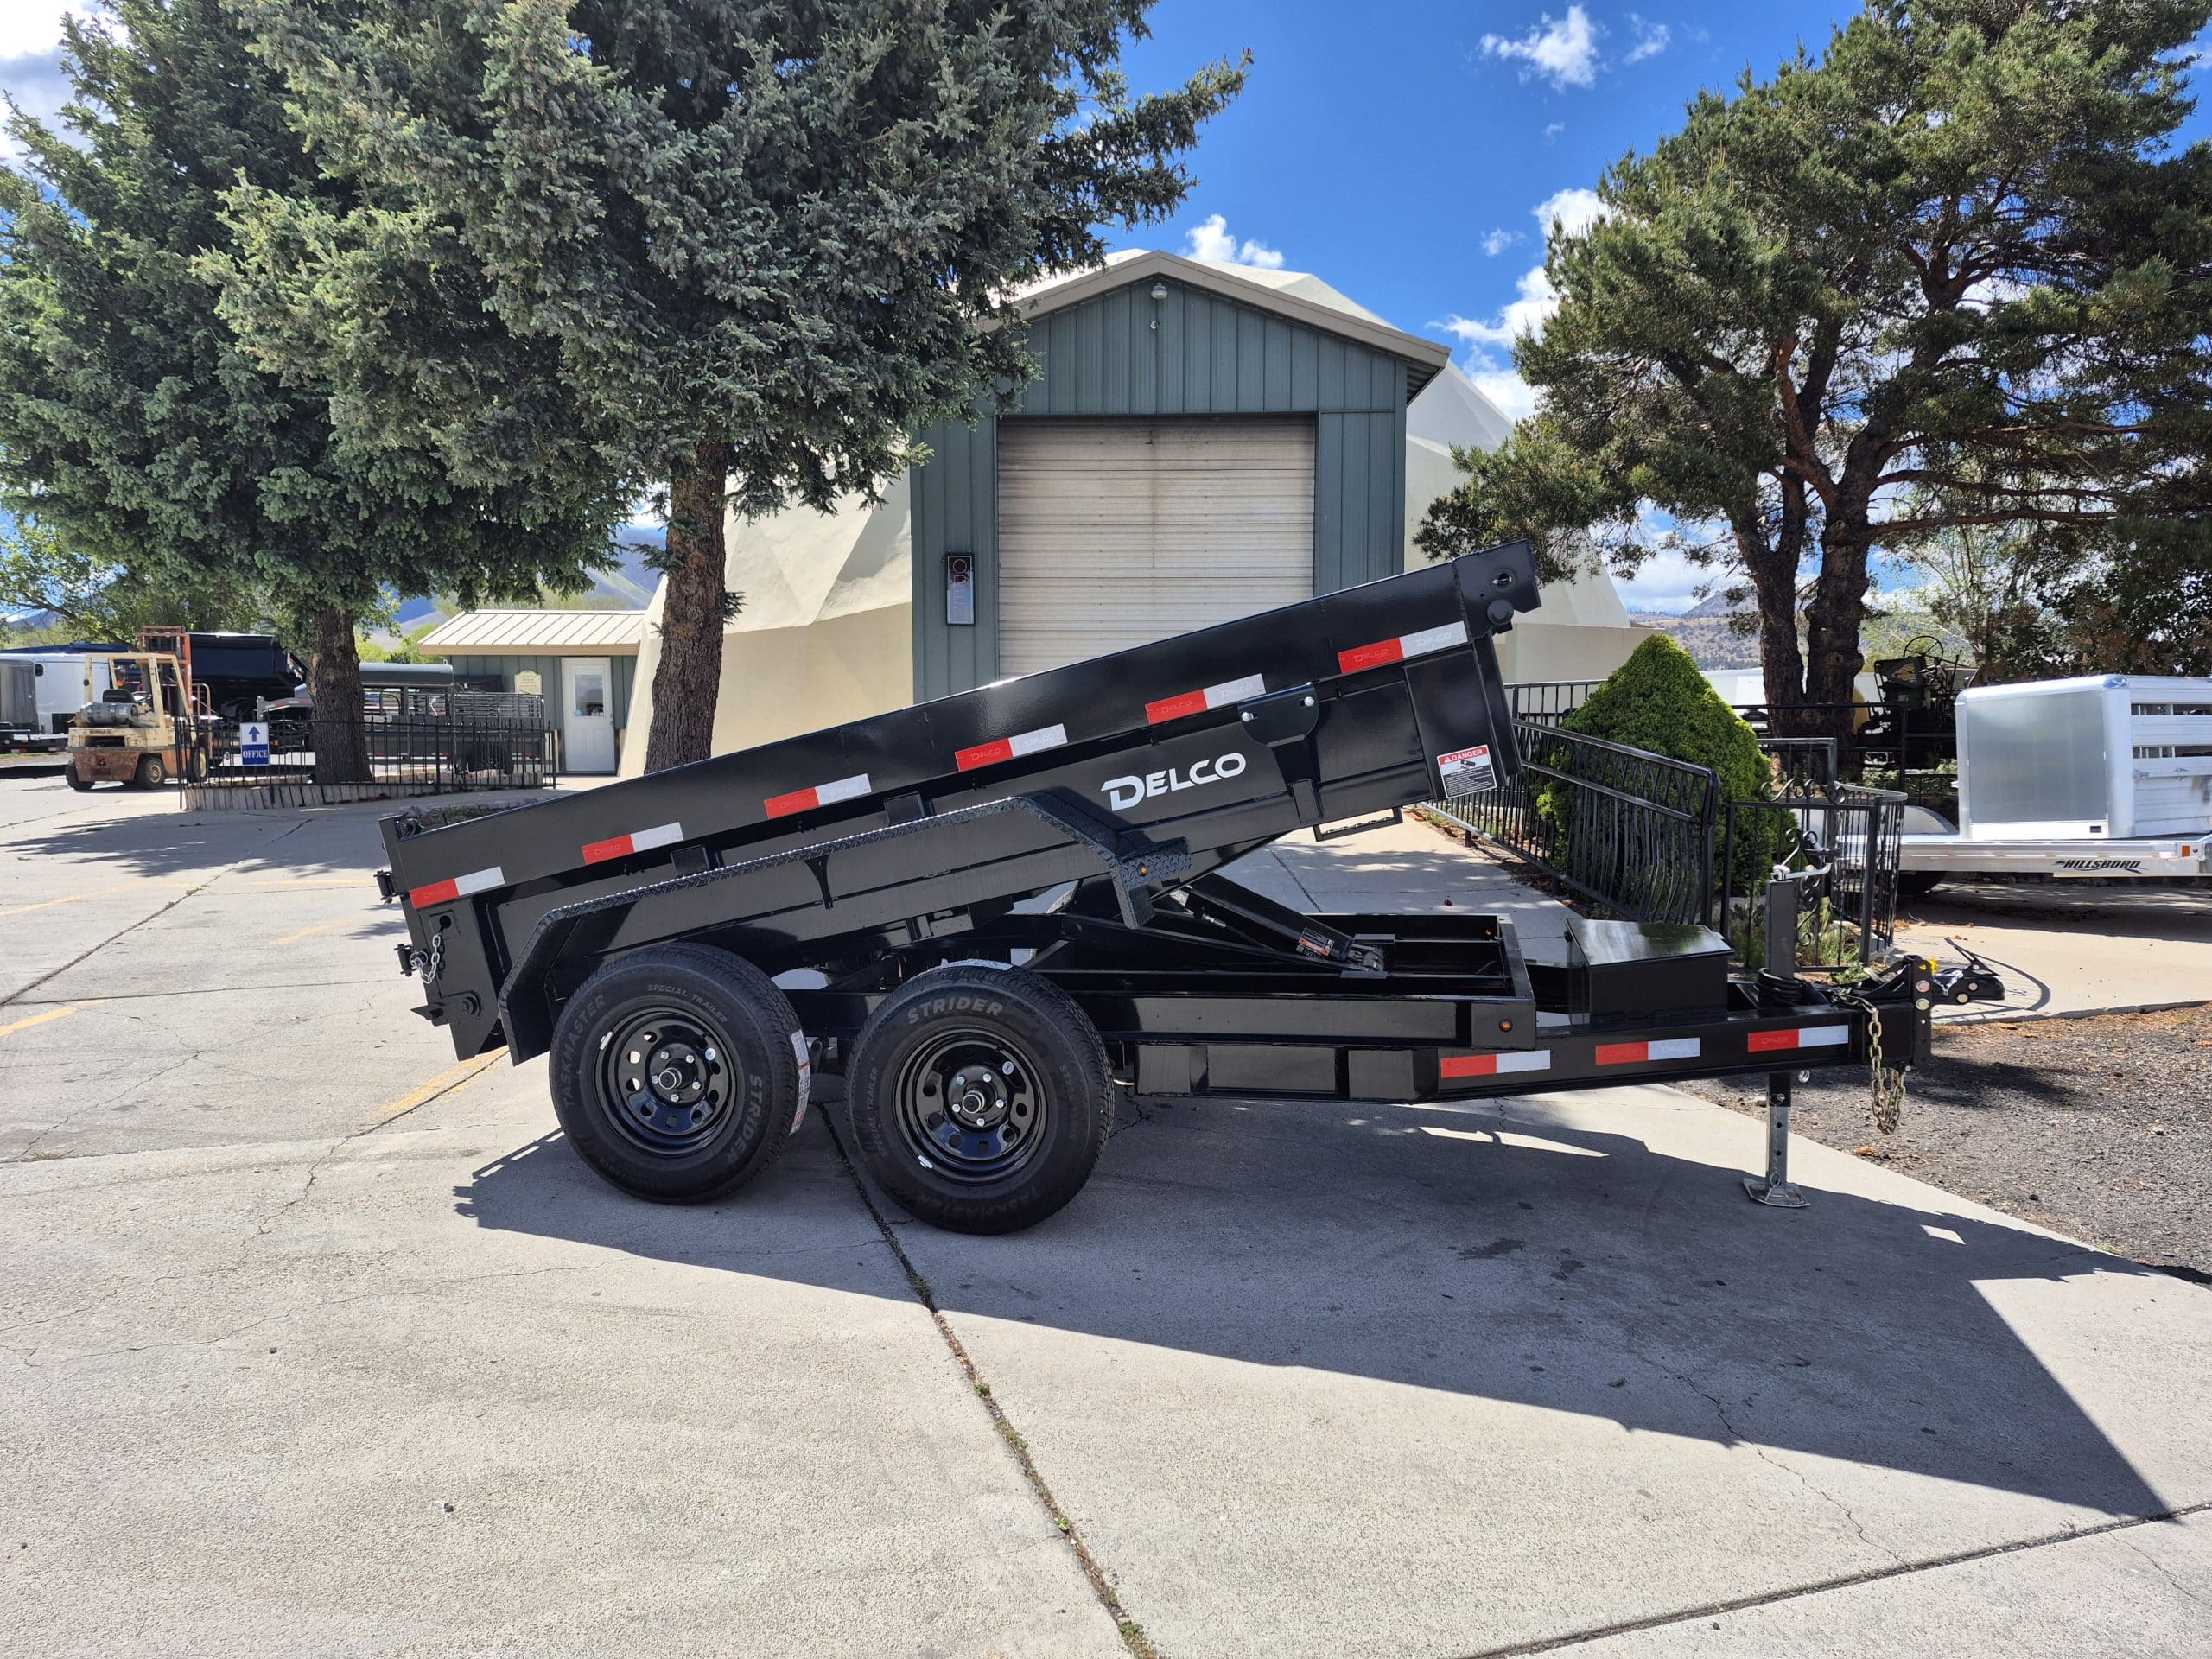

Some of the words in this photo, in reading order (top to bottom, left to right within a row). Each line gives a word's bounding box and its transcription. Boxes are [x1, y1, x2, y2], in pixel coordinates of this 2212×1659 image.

[1352, 648, 1390, 664] DELCO
[242, 749, 268, 759] OFFICE
[1451, 748, 1484, 761] DANGER
[1100, 752, 1247, 812] DELCO
[2061, 859, 2143, 870] HILLSBORO
[647, 983, 689, 999] SPECIAL
[690, 995, 728, 1024] TRAILER
[907, 995, 1004, 1025] STRIDER
[563, 994, 606, 1108] TASKMASTER
[867, 1067, 879, 1111] TRAILER
[726, 1072, 765, 1164] STRIDER
[867, 1114, 889, 1157] SPECIAL
